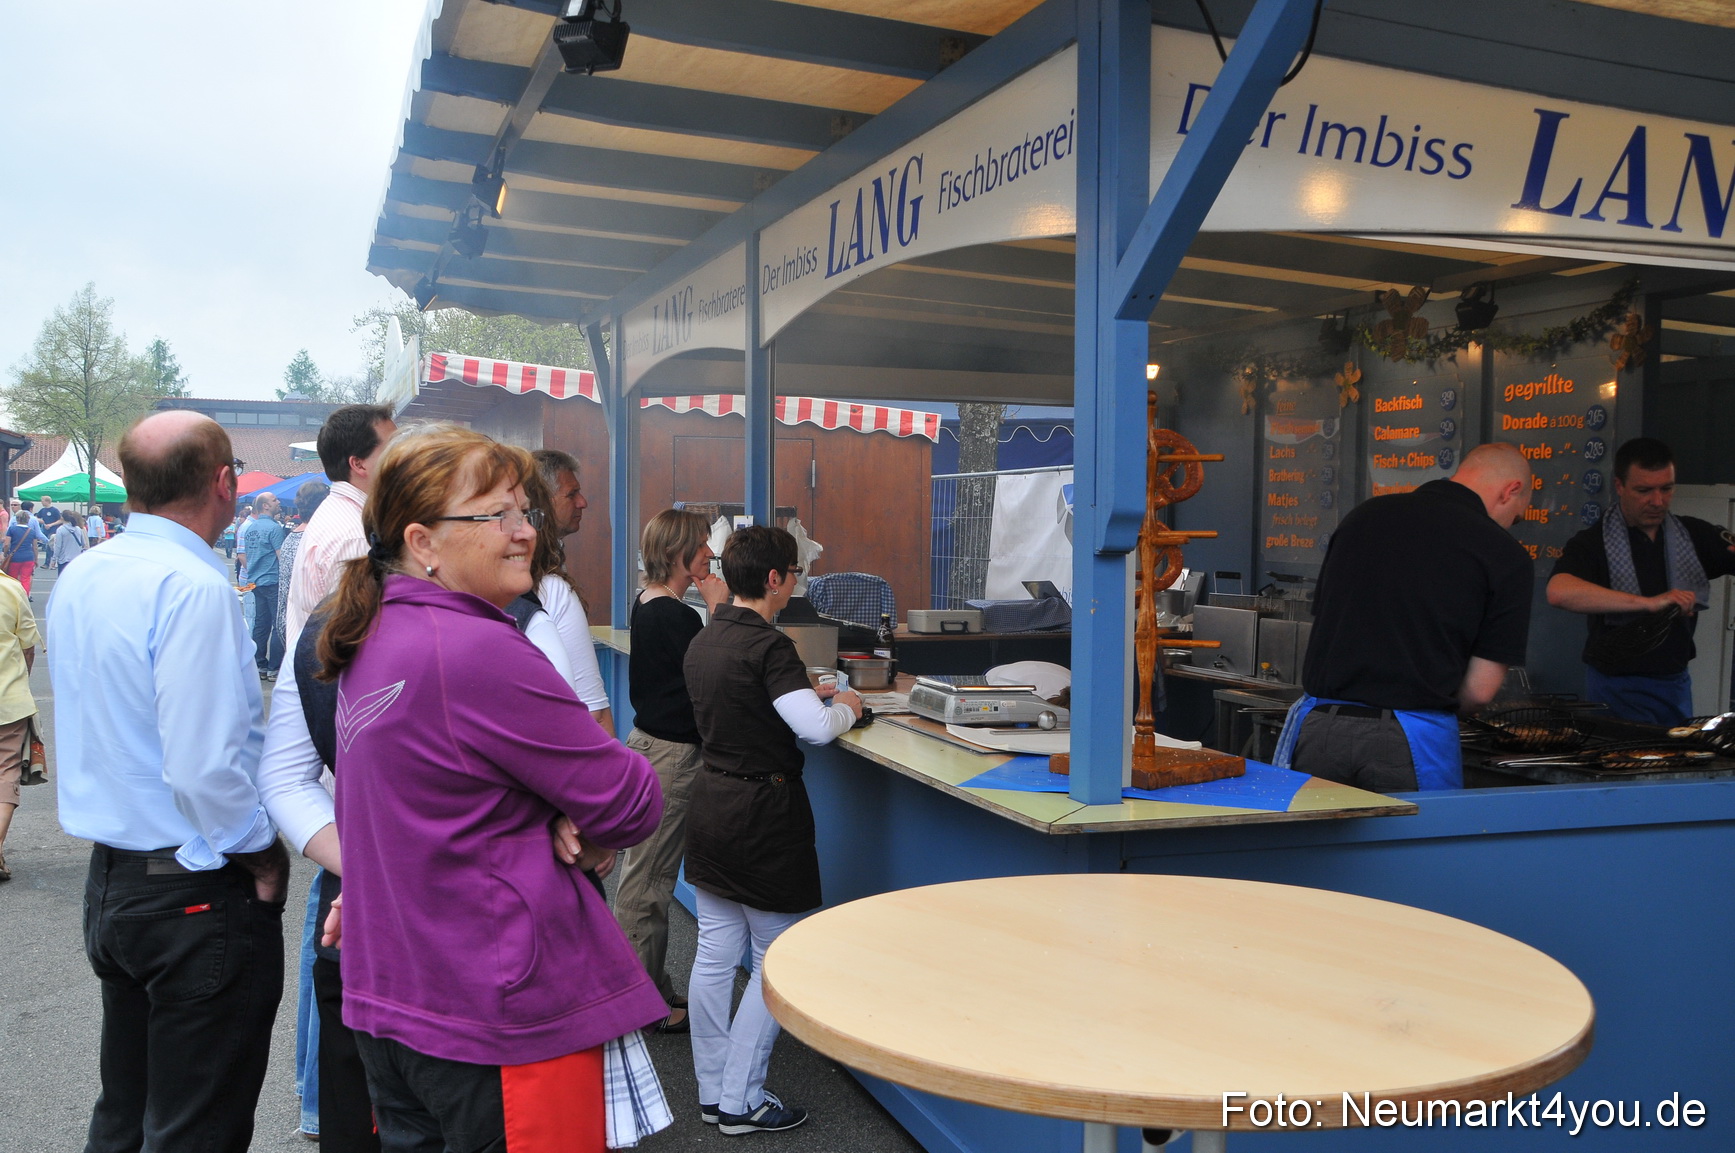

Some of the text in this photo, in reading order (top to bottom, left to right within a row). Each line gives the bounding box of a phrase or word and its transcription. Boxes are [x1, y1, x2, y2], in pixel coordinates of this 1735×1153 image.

[1177, 83, 1735, 238] Dr Imbiss LAN
[762, 109, 1075, 295] Der Imbiss LANG Fischbraterei
[652, 285, 693, 356] LANG
[699, 284, 746, 326] Fischbratere
[1504, 373, 1574, 402] gegrillte
[1375, 394, 1423, 413] Backfisch
[1502, 412, 1549, 431] Dorade
[1374, 425, 1420, 441] Calamare
[1269, 445, 1297, 459] Lachs
[1520, 442, 1552, 460] krele
[1373, 453, 1398, 469] Fisch
[1399, 456, 1407, 465] +
[1407, 452, 1435, 469] Chips
[1268, 468, 1305, 484] Brathering
[1267, 493, 1299, 509] Matjes
[1265, 534, 1289, 549] große
[1290, 534, 1314, 548] Breze
